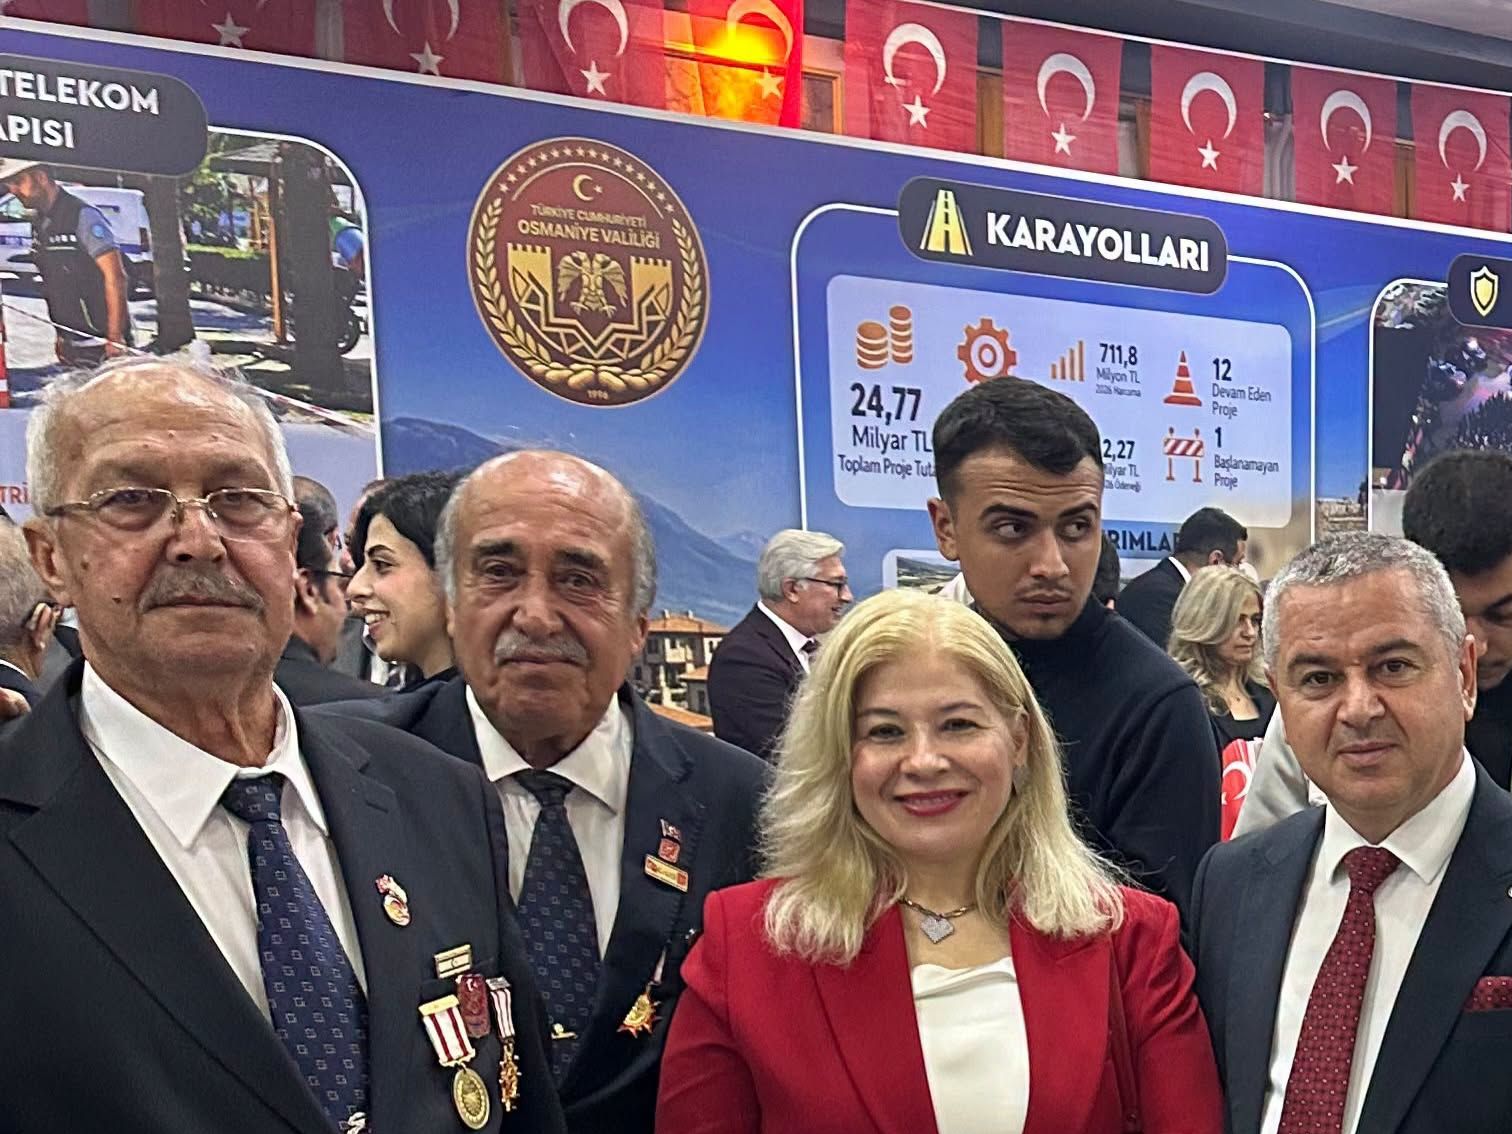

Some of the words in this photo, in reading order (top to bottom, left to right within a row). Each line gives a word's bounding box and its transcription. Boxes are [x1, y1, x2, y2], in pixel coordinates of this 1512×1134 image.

[0, 69, 159, 115] TELEKOM
[518, 219, 600, 242] OSMANİYE
[600, 227, 661, 249] VALİLİĞİ
[986, 211, 1209, 272] KARAYOLLARI
[1099, 342, 1138, 369] 711,8
[1096, 366, 1127, 384] Milyon
[1128, 370, 1141, 384] TL
[1212, 358, 1232, 382] 12
[850, 382, 922, 426] 24,77
[1212, 383, 1246, 400] Devam
[1248, 386, 1272, 402] Eden
[1212, 401, 1238, 419] Proje
[852, 424, 908, 455] Milyar
[911, 430, 933, 452] TL
[1214, 426, 1223, 448] 1
[1103, 438, 1136, 462] 2,27
[838, 454, 881, 475] Toplam
[883, 458, 913, 479] Proje
[1127, 463, 1140, 477] TL
[1214, 453, 1280, 476] Başlanamayan
[1214, 472, 1239, 491] Proje
